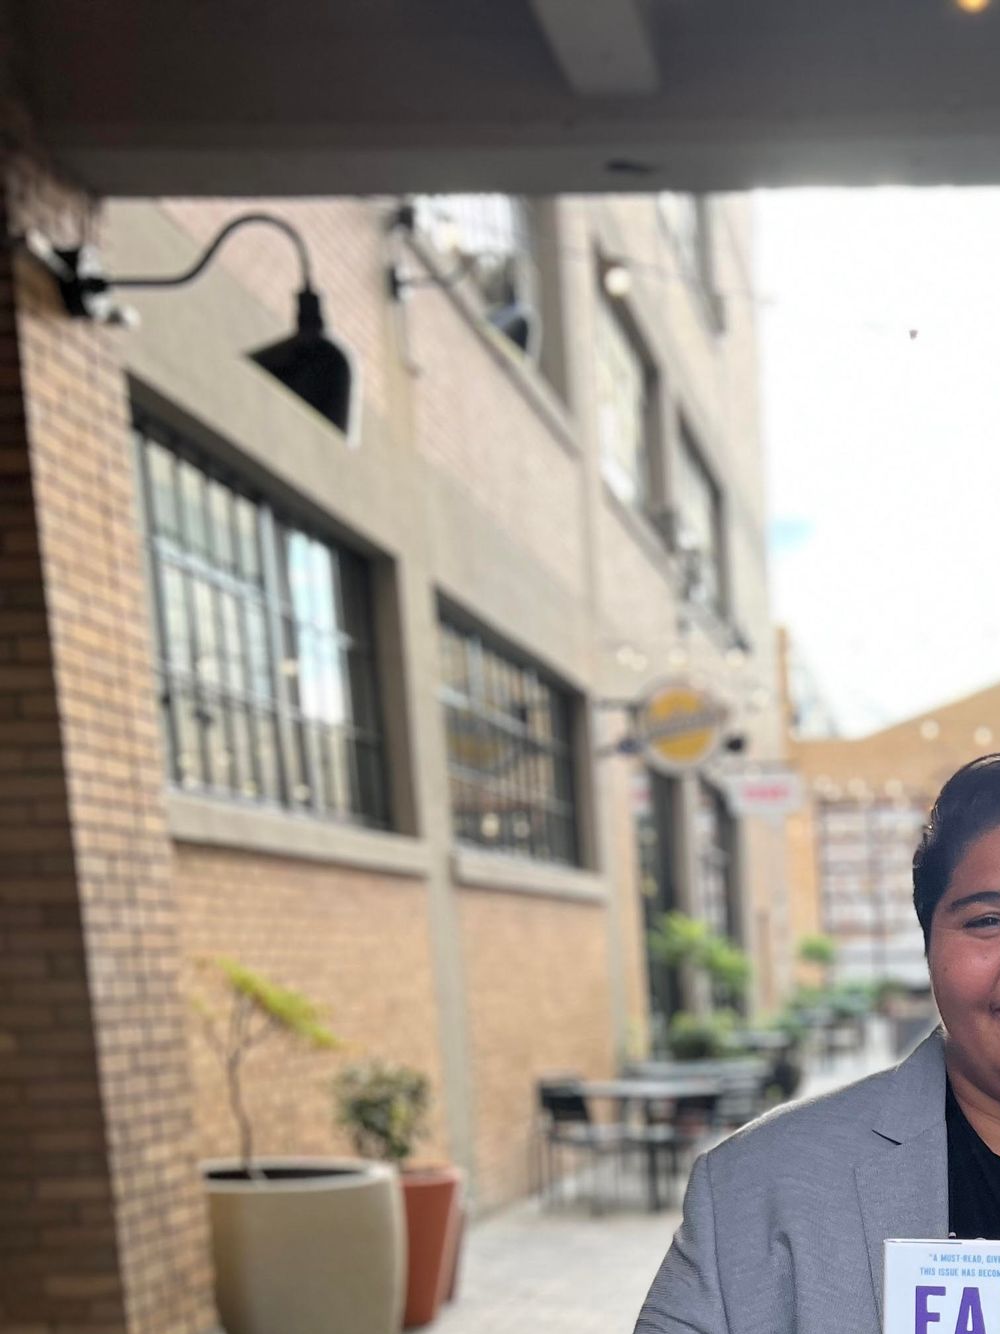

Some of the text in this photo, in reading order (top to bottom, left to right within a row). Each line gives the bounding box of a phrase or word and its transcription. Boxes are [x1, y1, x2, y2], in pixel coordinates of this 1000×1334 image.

[940, 1254, 984, 1264] MUST-READ,
[920, 1267, 936, 1276] THIS
[938, 1268, 959, 1277] ISSUE
[961, 1268, 976, 1277] HAS
